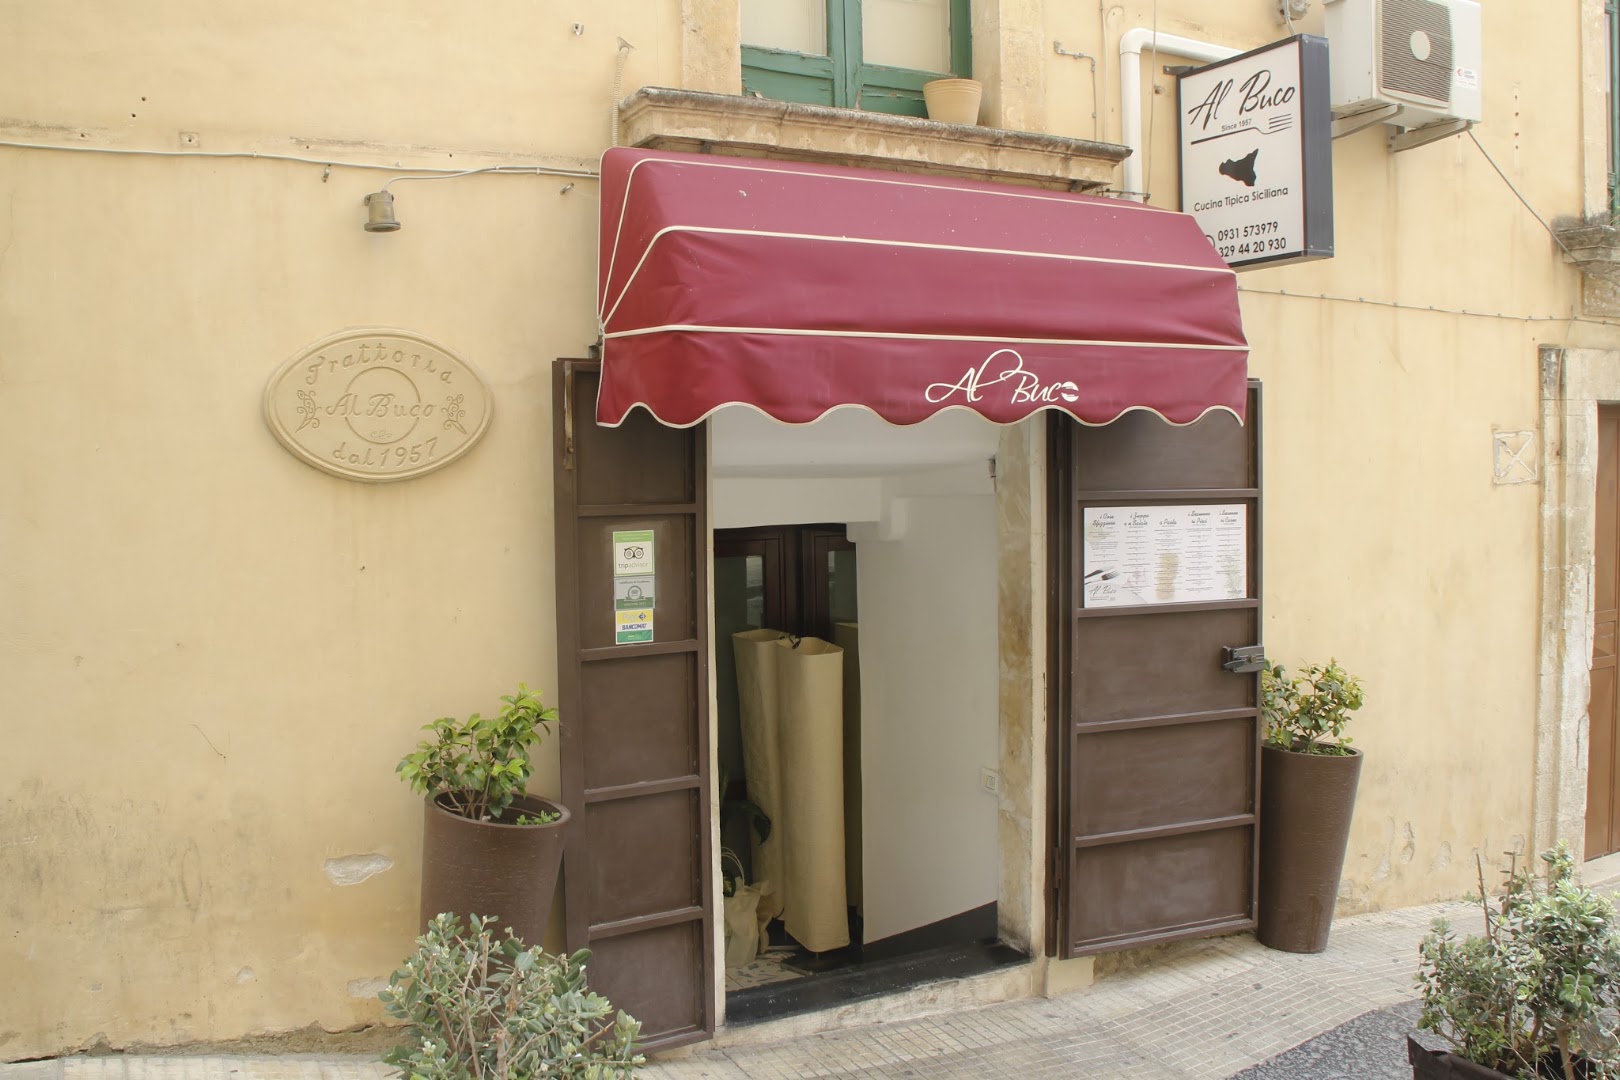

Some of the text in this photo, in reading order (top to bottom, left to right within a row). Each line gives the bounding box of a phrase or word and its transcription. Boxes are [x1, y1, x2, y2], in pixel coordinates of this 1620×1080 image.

[1188, 69, 1295, 131] Al Buco
[1221, 118, 1252, 132] Since 1957
[1194, 186, 1289, 212] Cucina Tipica Siciliana
[1217, 221, 1279, 242] 0931 573979
[1218, 237, 1287, 258] 329 44 20 930
[305, 342, 454, 386] Trattoria
[925, 348, 1005, 404] Al
[325, 393, 438, 419] Al Buco
